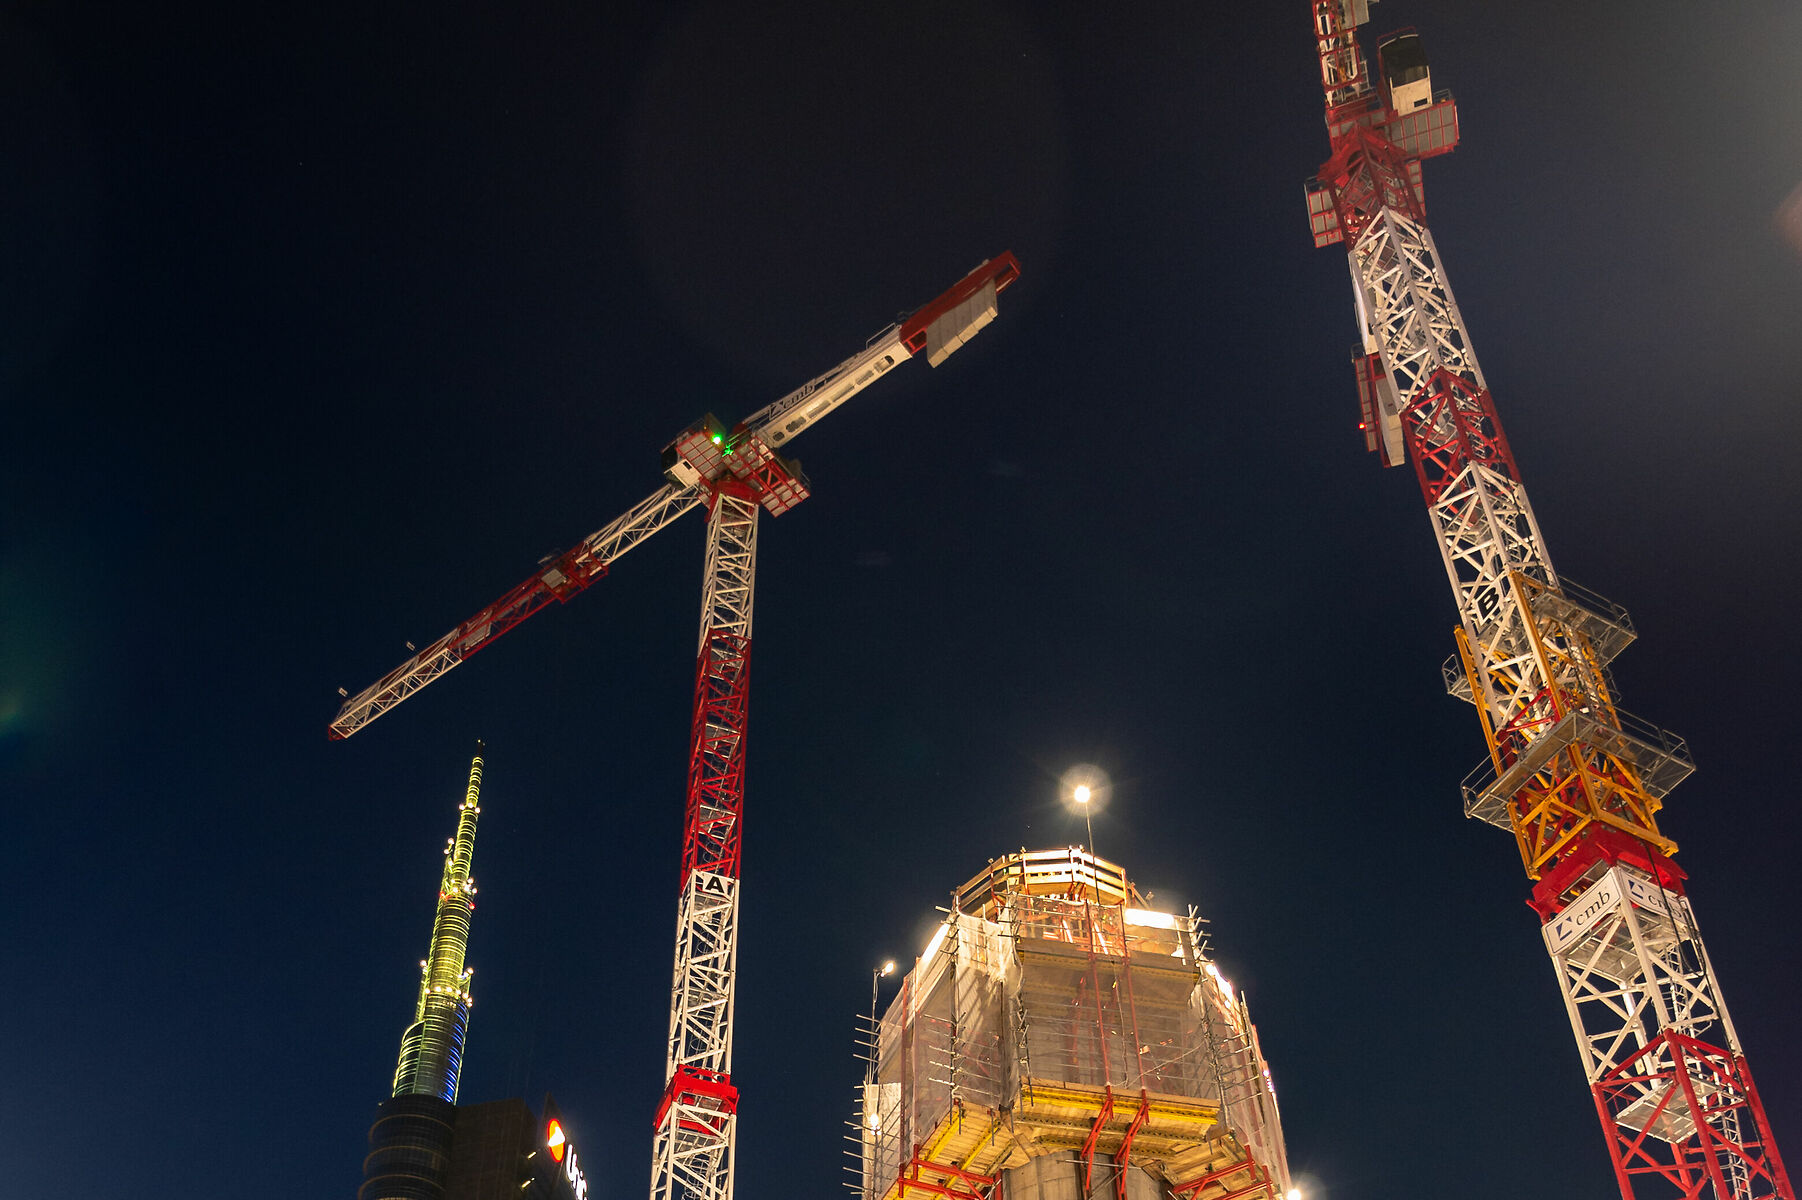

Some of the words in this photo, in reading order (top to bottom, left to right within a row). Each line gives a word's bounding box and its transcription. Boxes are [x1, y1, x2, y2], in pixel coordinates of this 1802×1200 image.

[1477, 586, 1499, 620] B
[705, 876, 725, 894] A
[1576, 891, 1611, 926] cmb
